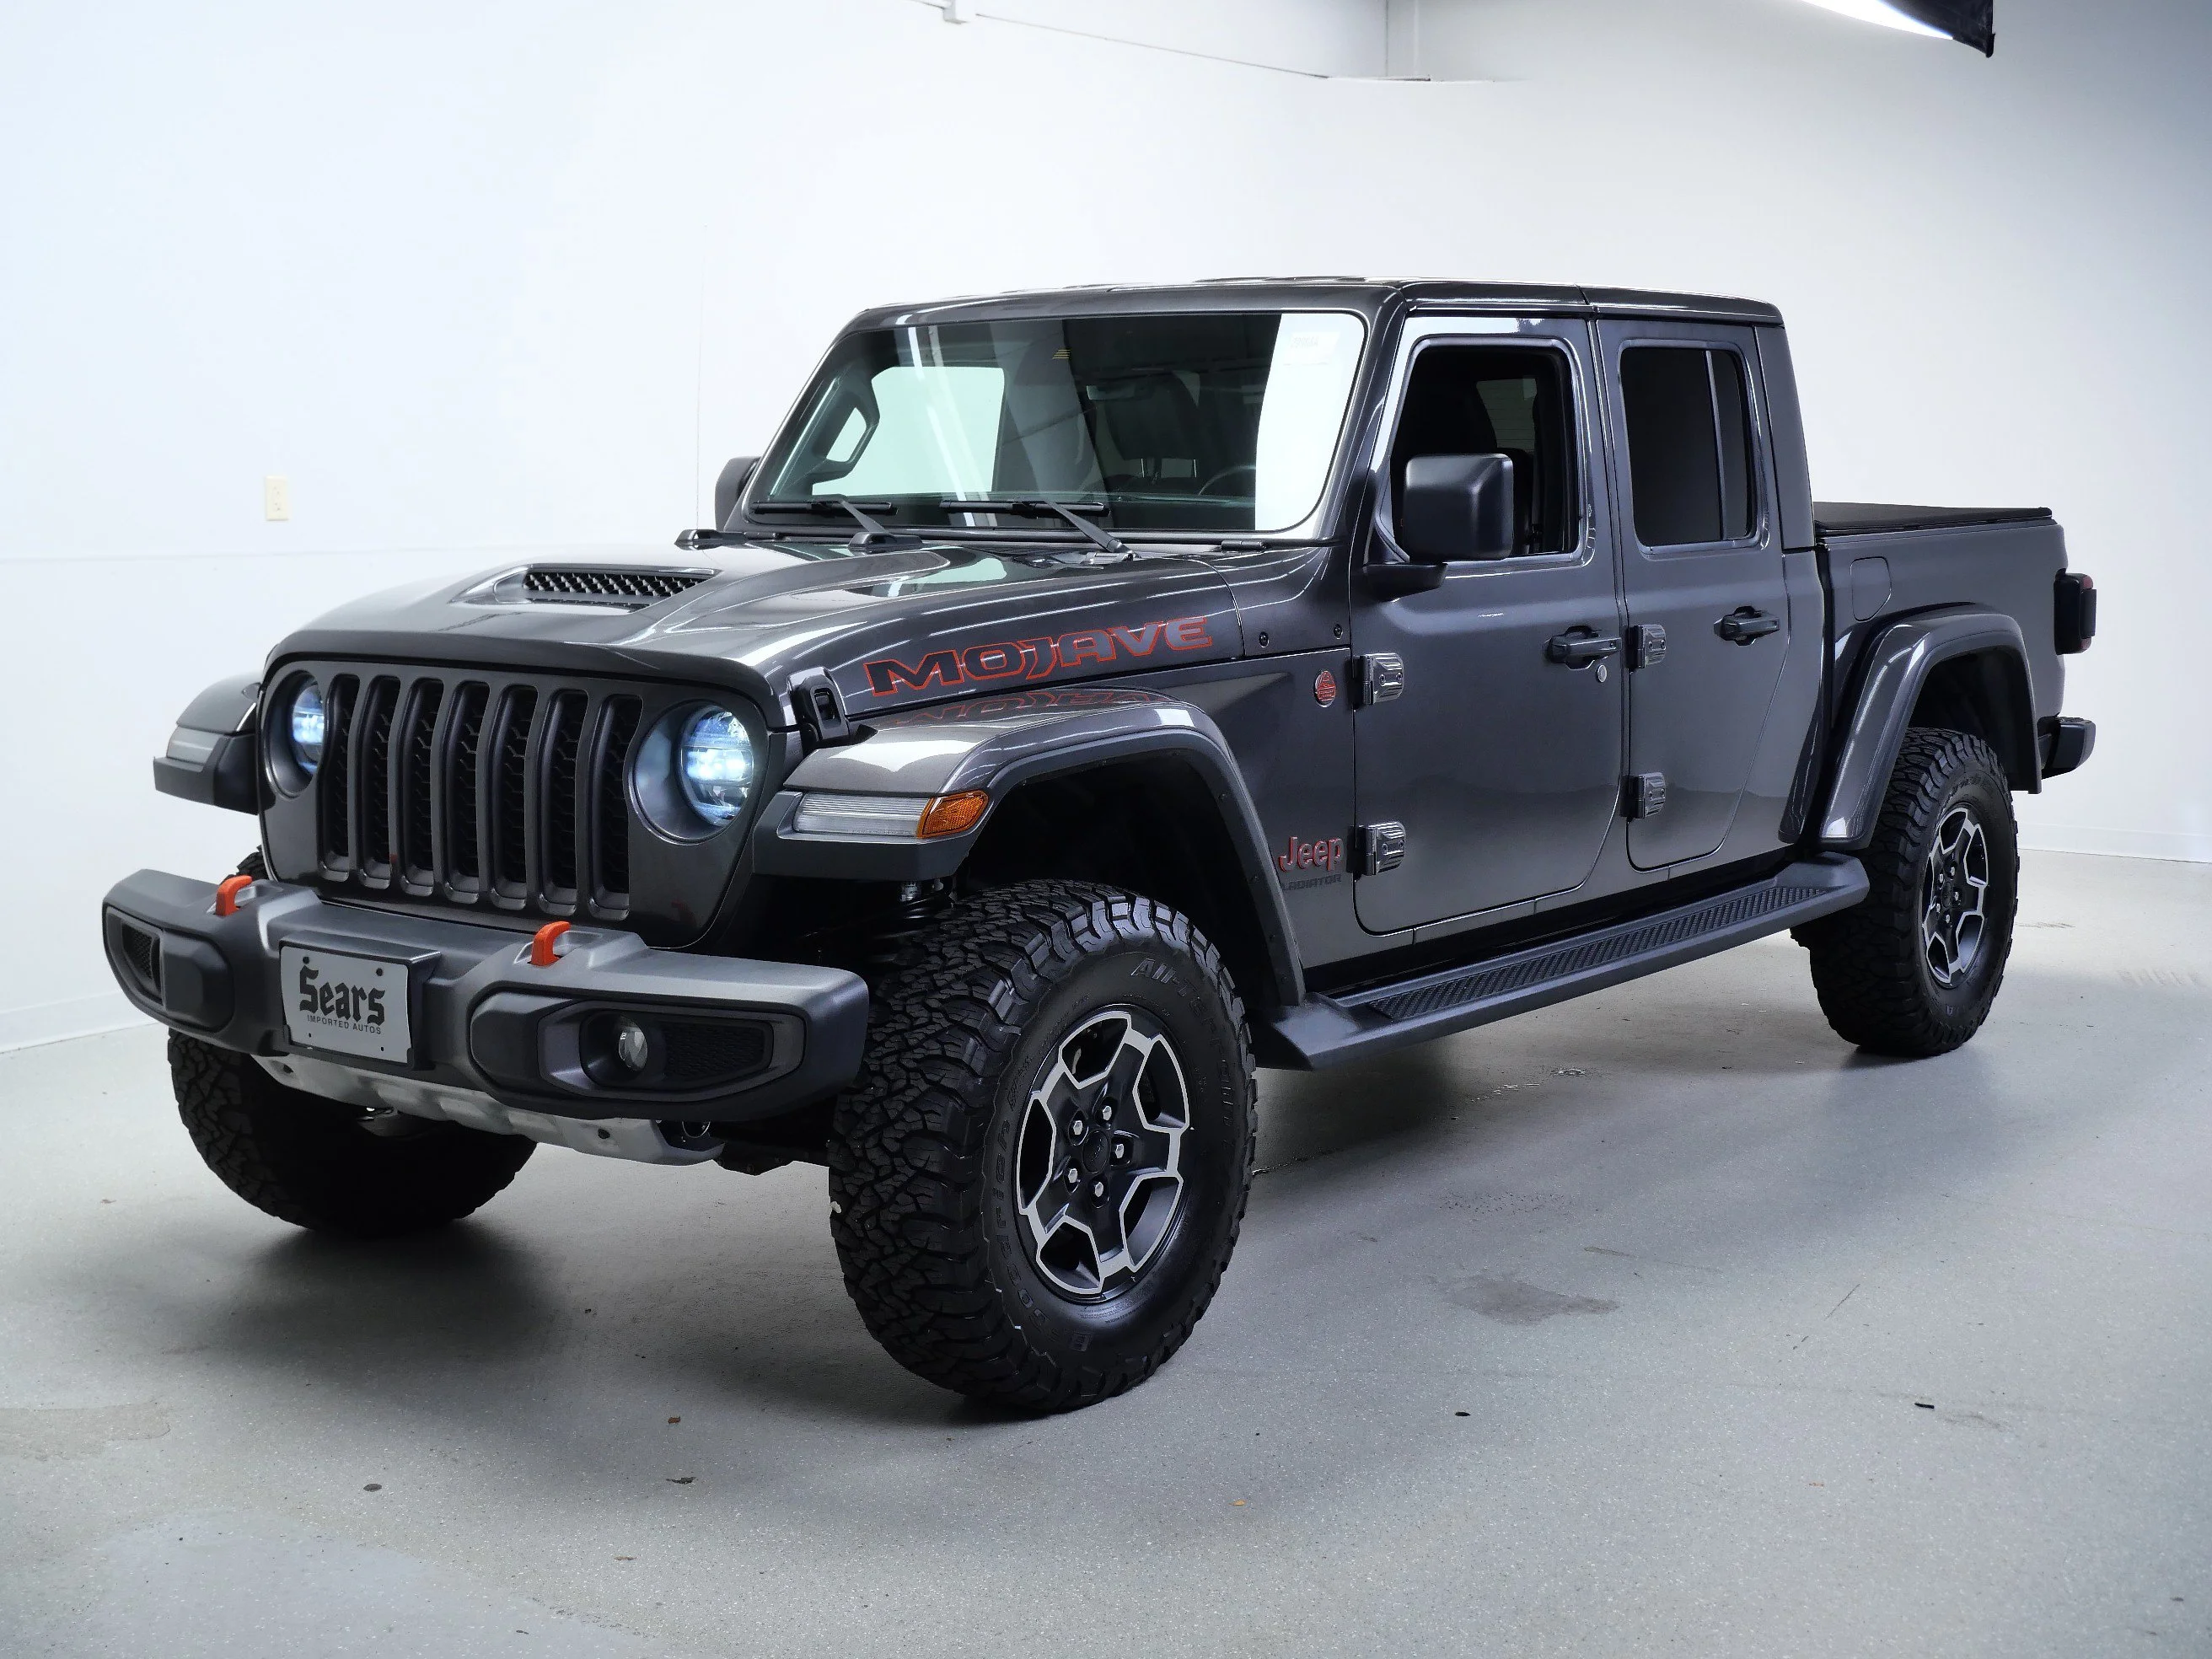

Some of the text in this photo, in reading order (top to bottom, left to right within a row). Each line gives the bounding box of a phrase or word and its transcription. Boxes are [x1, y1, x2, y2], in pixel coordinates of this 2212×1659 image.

[863, 616, 1212, 696] MOJAVE
[1279, 836, 1345, 872] Jeep
[299, 965, 385, 1027] Sears
[307, 1014, 381, 1034] IMPORTED AUTOS
